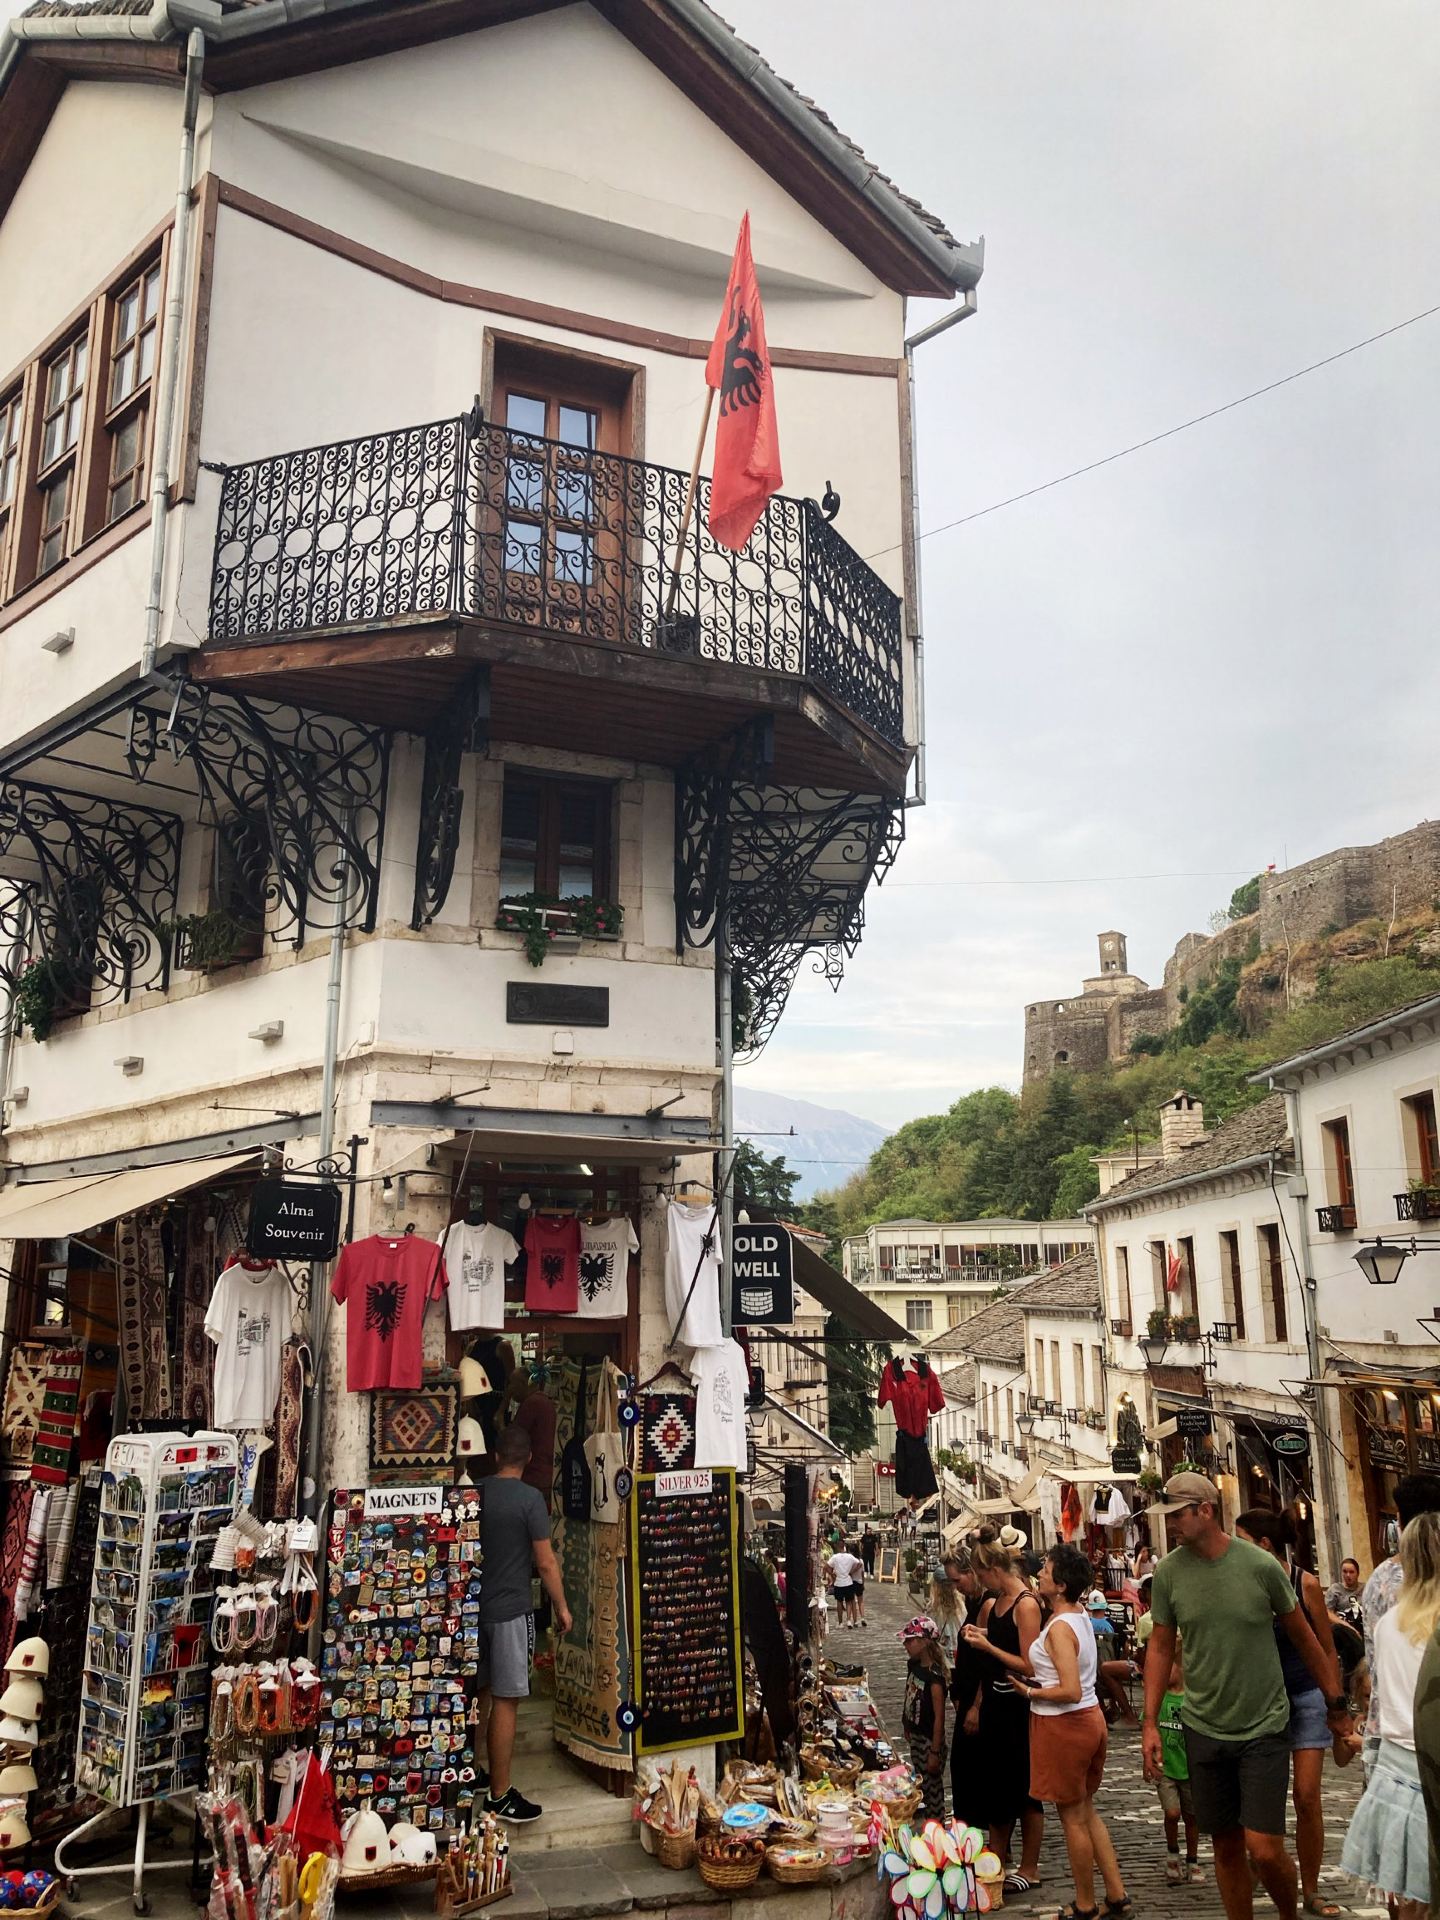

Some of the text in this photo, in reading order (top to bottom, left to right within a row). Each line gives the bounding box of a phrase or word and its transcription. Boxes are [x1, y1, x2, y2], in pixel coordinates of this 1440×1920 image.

[278, 1202, 314, 1216] Alma
[265, 1223, 325, 1240] Souvenir
[734, 1236, 778, 1252] OLD
[734, 1262, 780, 1277] WELL
[659, 1473, 709, 1491] SILVER 925
[369, 1492, 437, 1509] MAGNETS
